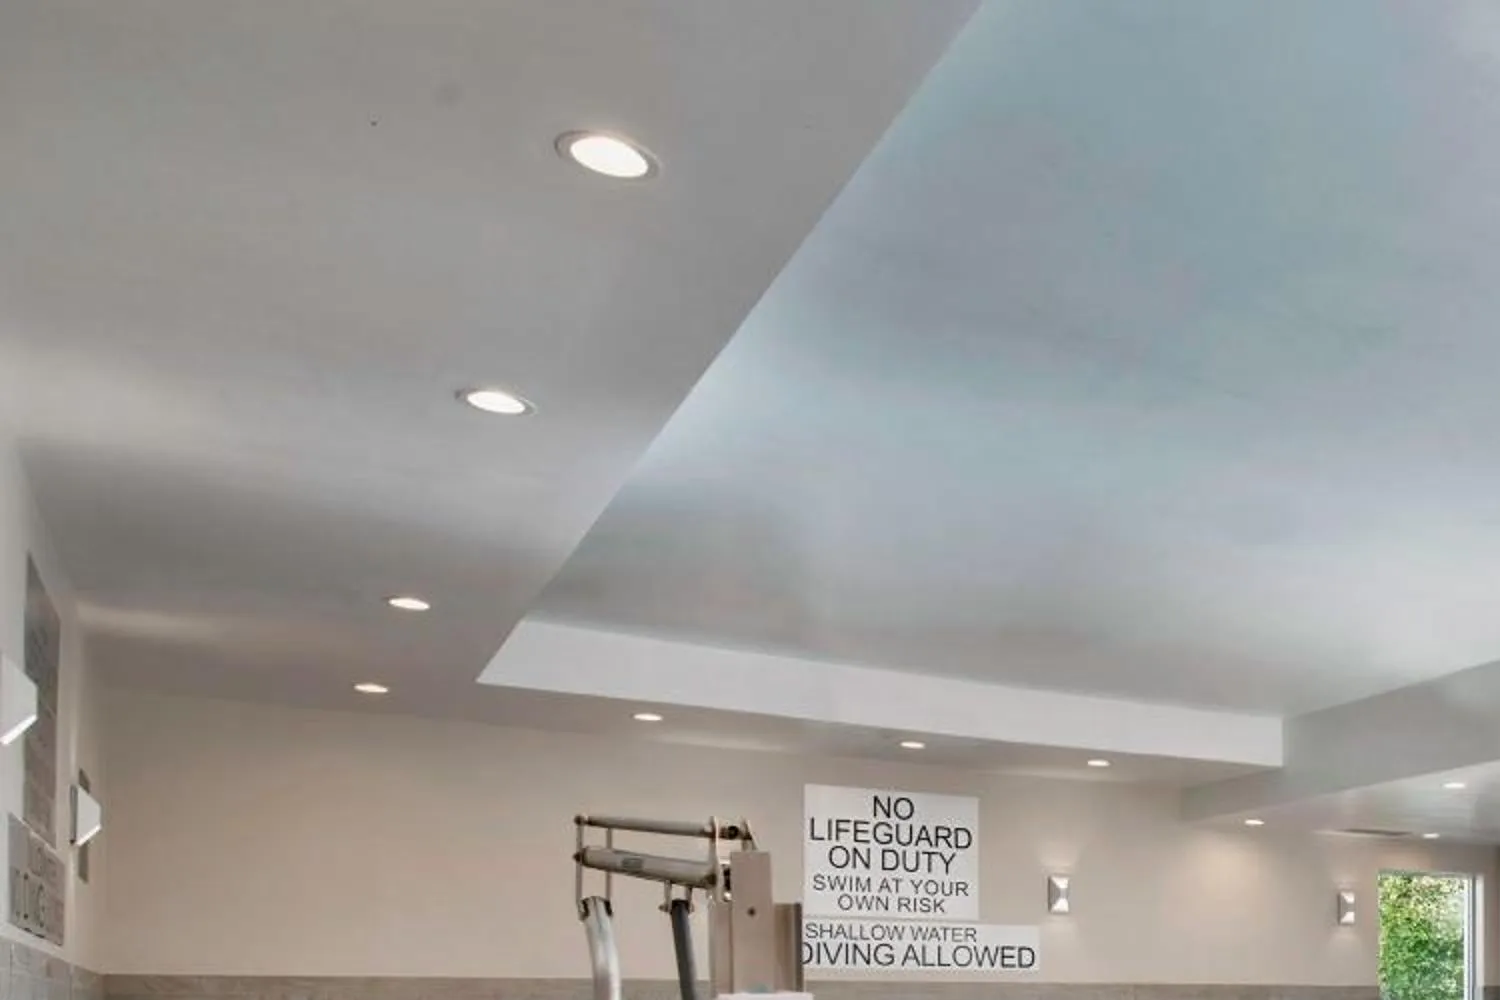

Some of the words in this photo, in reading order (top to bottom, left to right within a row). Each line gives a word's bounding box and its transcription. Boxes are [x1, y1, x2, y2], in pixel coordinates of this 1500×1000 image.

[873, 796, 914, 820] NO
[809, 817, 973, 849] LIFEGUARD
[828, 846, 871, 869] ON
[881, 849, 956, 874] DUTY
[812, 874, 871, 892] SWIM
[877, 877, 903, 893] AT
[911, 880, 969, 897] YOUR
[837, 894, 889, 911] OWN
[897, 897, 945, 913] RISK
[805, 922, 905, 941] SHALLOW
[910, 926, 977, 942] WATER
[801, 942, 895, 966] DIVING
[901, 945, 1036, 969] ALLOWED
